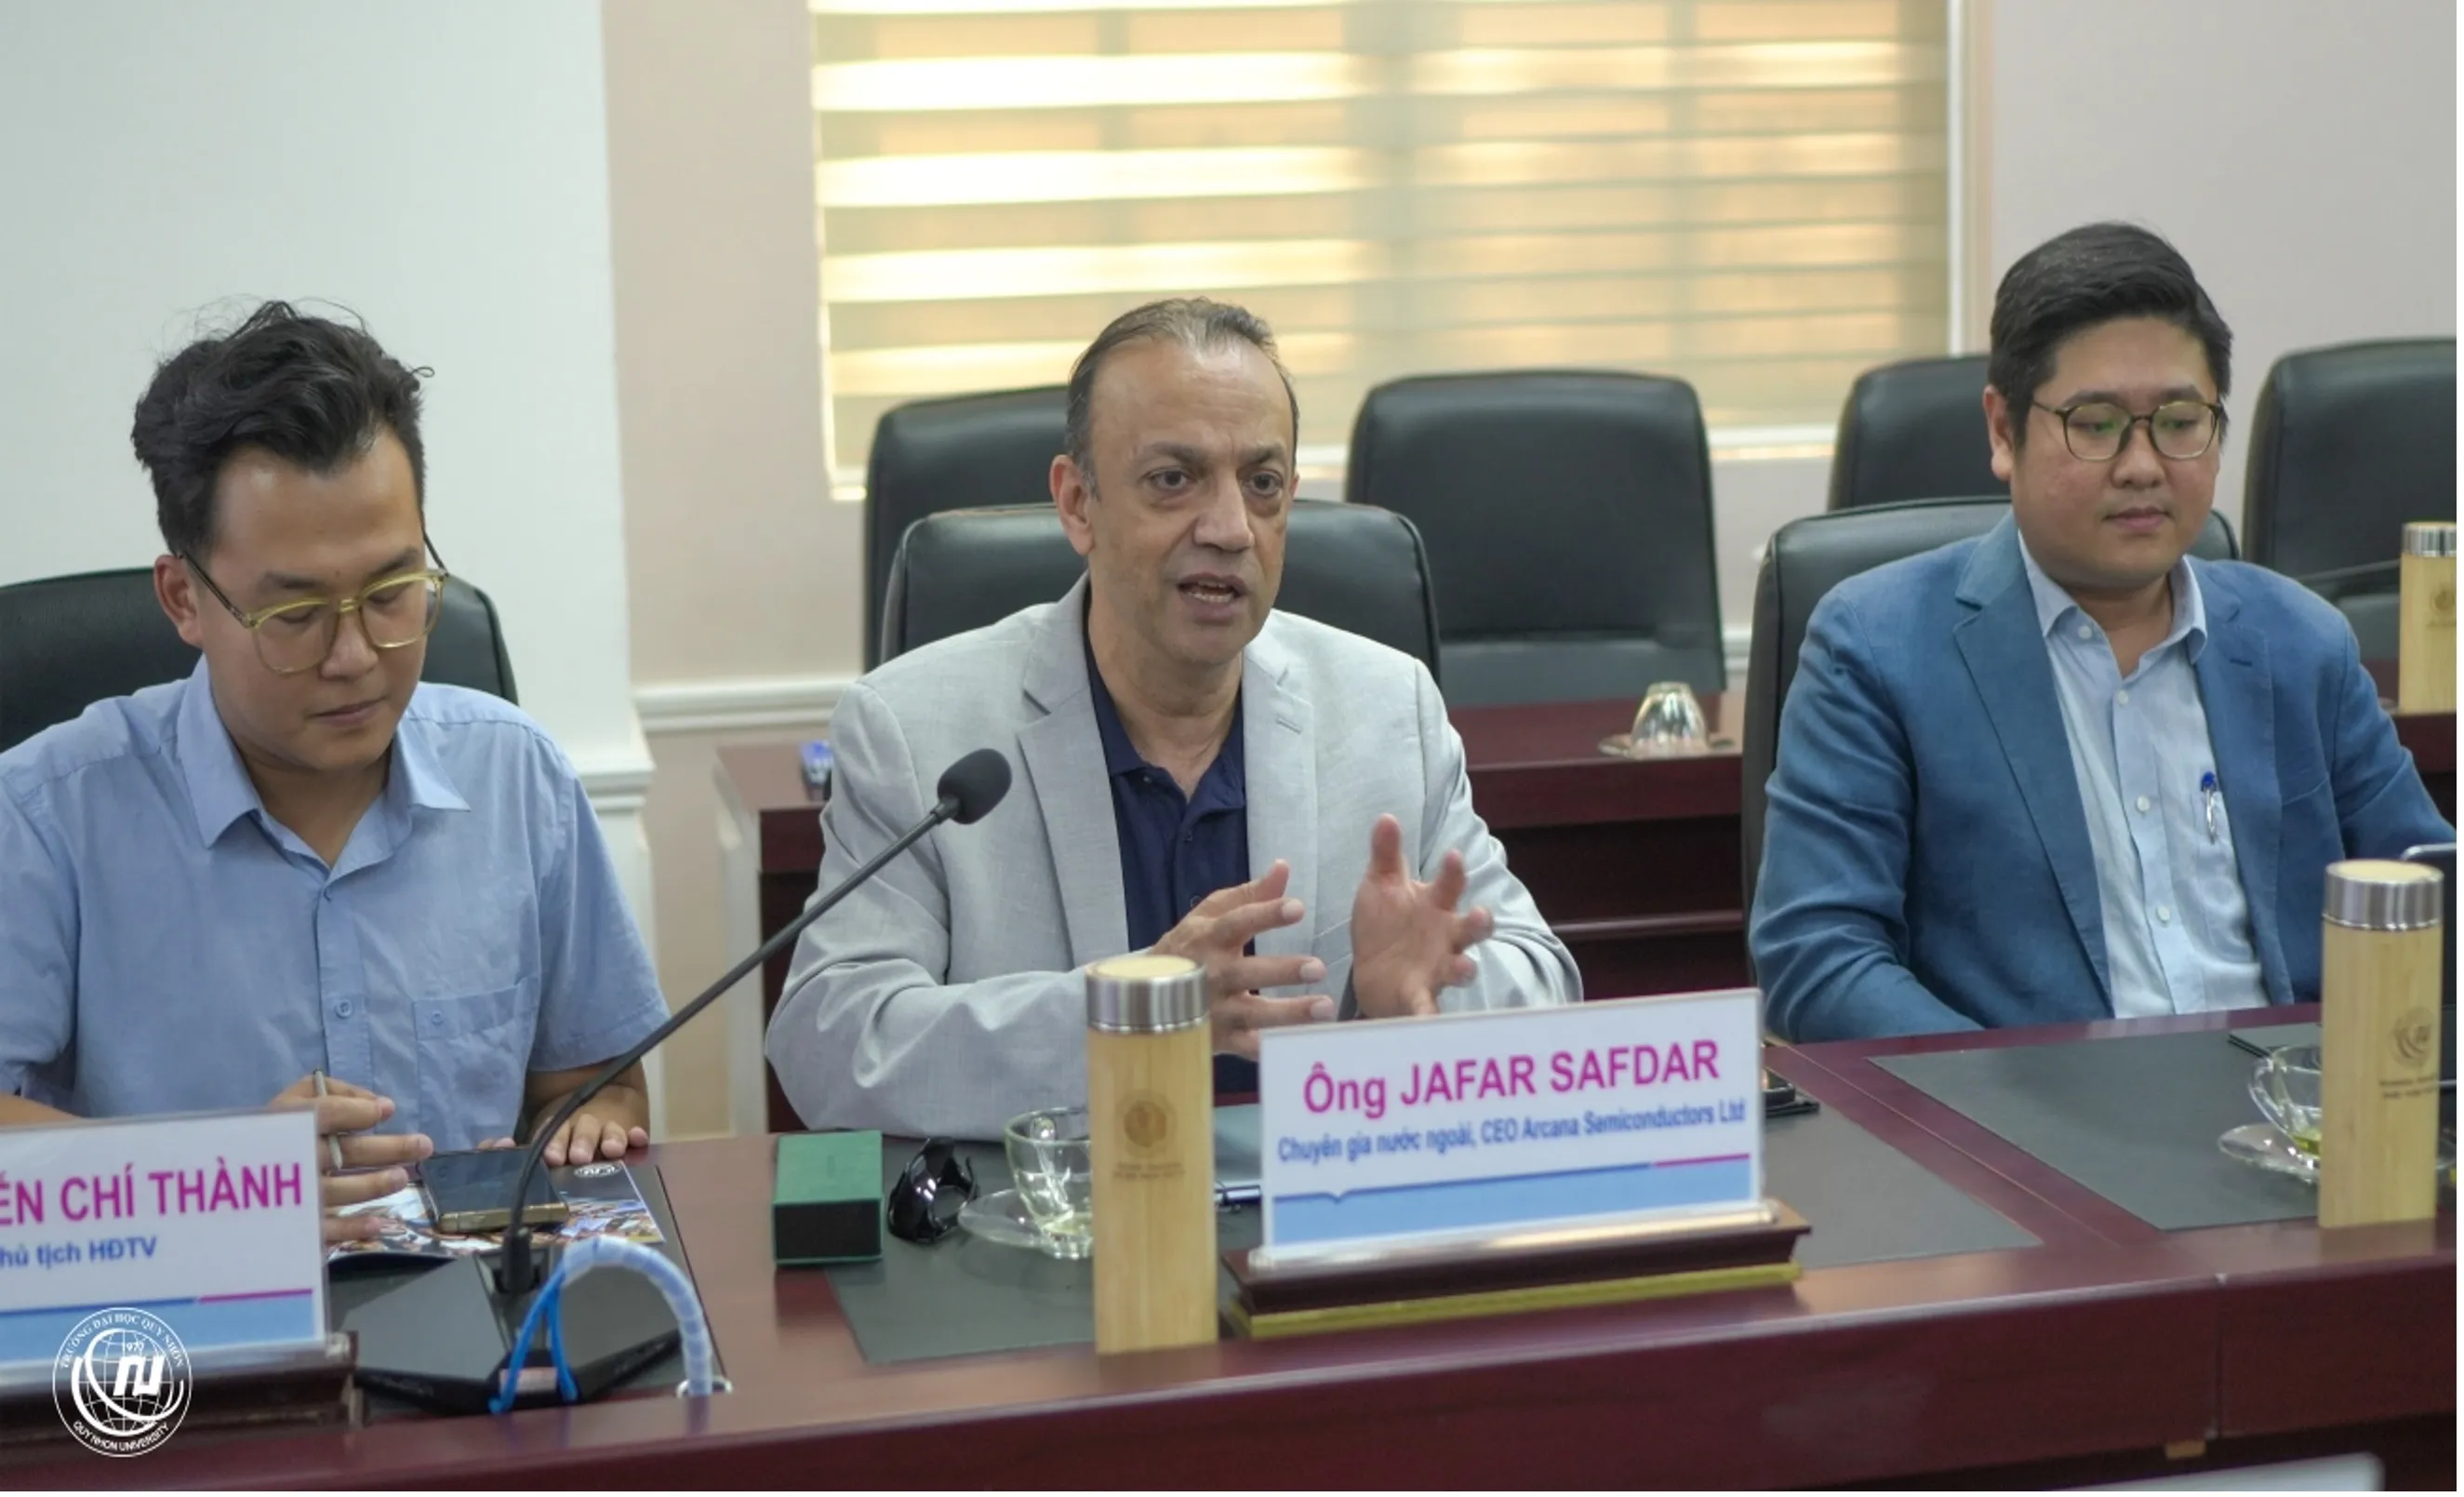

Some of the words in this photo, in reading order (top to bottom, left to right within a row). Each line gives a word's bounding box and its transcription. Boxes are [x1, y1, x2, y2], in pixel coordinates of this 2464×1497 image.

[1303, 1061, 1387, 1119] Ông
[1399, 1053, 1538, 1106] JAFAR
[1549, 1038, 1721, 1093] SAFDAR
[1347, 1132, 1372, 1162] gia
[1481, 1116, 1519, 1144] CEO
[1522, 1116, 1579, 1140] Arcana
[1584, 1104, 1714, 1134] Semiconductors
[1720, 1098, 1746, 1122] Ltd
[59, 1162, 135, 1222] CHÍ
[148, 1156, 302, 1216] THÀNH
[36, 1241, 81, 1271] tịch
[88, 1235, 158, 1262] HĐTV
